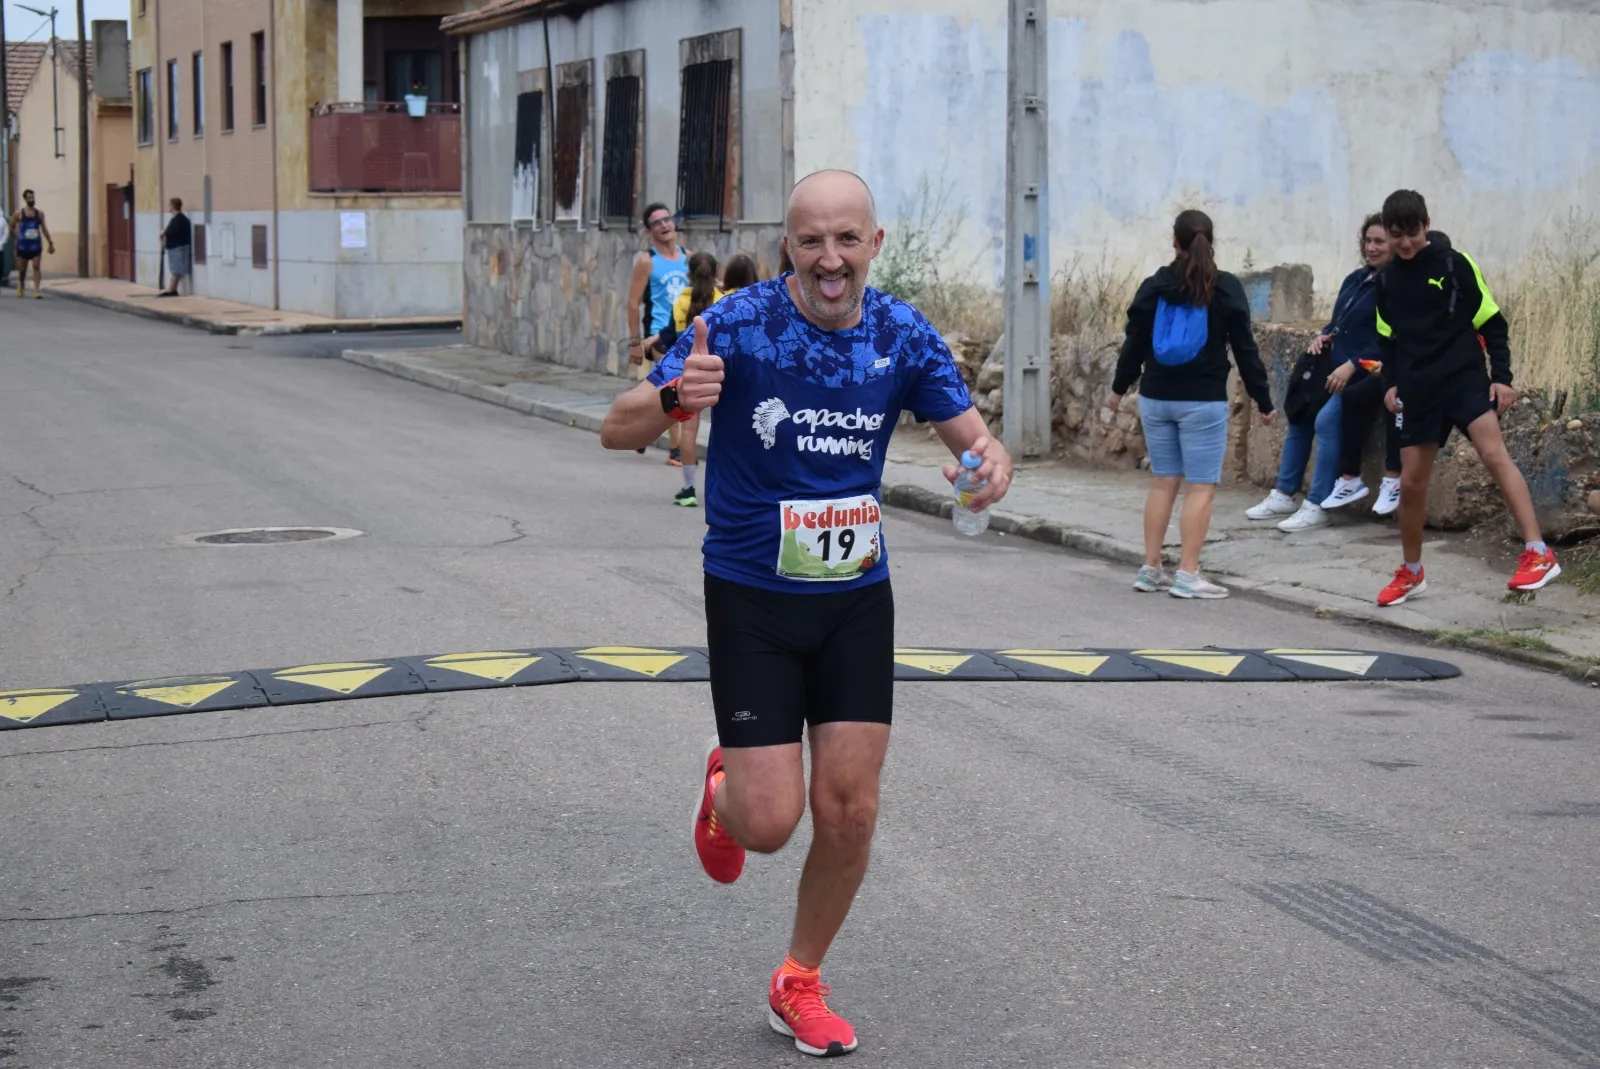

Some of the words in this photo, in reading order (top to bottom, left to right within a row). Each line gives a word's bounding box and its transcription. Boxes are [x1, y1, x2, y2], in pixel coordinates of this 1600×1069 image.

[797, 434, 874, 461] running
[783, 501, 880, 530] bedunia
[817, 528, 856, 561] 19
